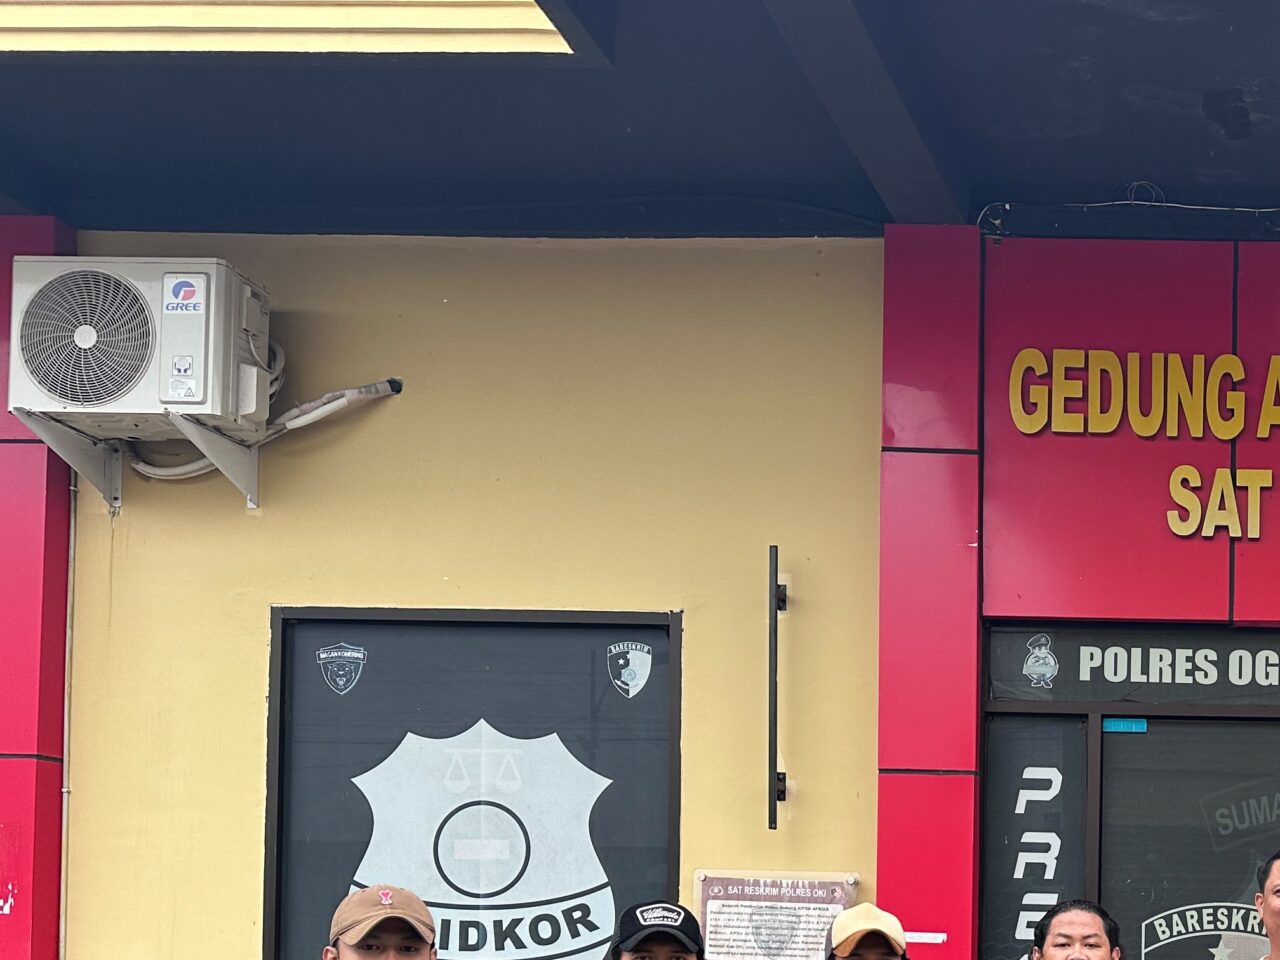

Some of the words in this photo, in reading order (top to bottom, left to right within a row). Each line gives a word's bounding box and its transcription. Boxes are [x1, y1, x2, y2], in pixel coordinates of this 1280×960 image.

[165, 302, 202, 312] GREE
[1009, 348, 1246, 441] GEDUNG
[1166, 464, 1273, 539] SAT
[1079, 645, 1218, 685] POLRES
[727, 885, 743, 895] SAT
[744, 885, 779, 896] RESKRIM
[780, 886, 811, 897] POLRES
[813, 888, 827, 898] OKI
[1153, 907, 1267, 941] BARESKR
